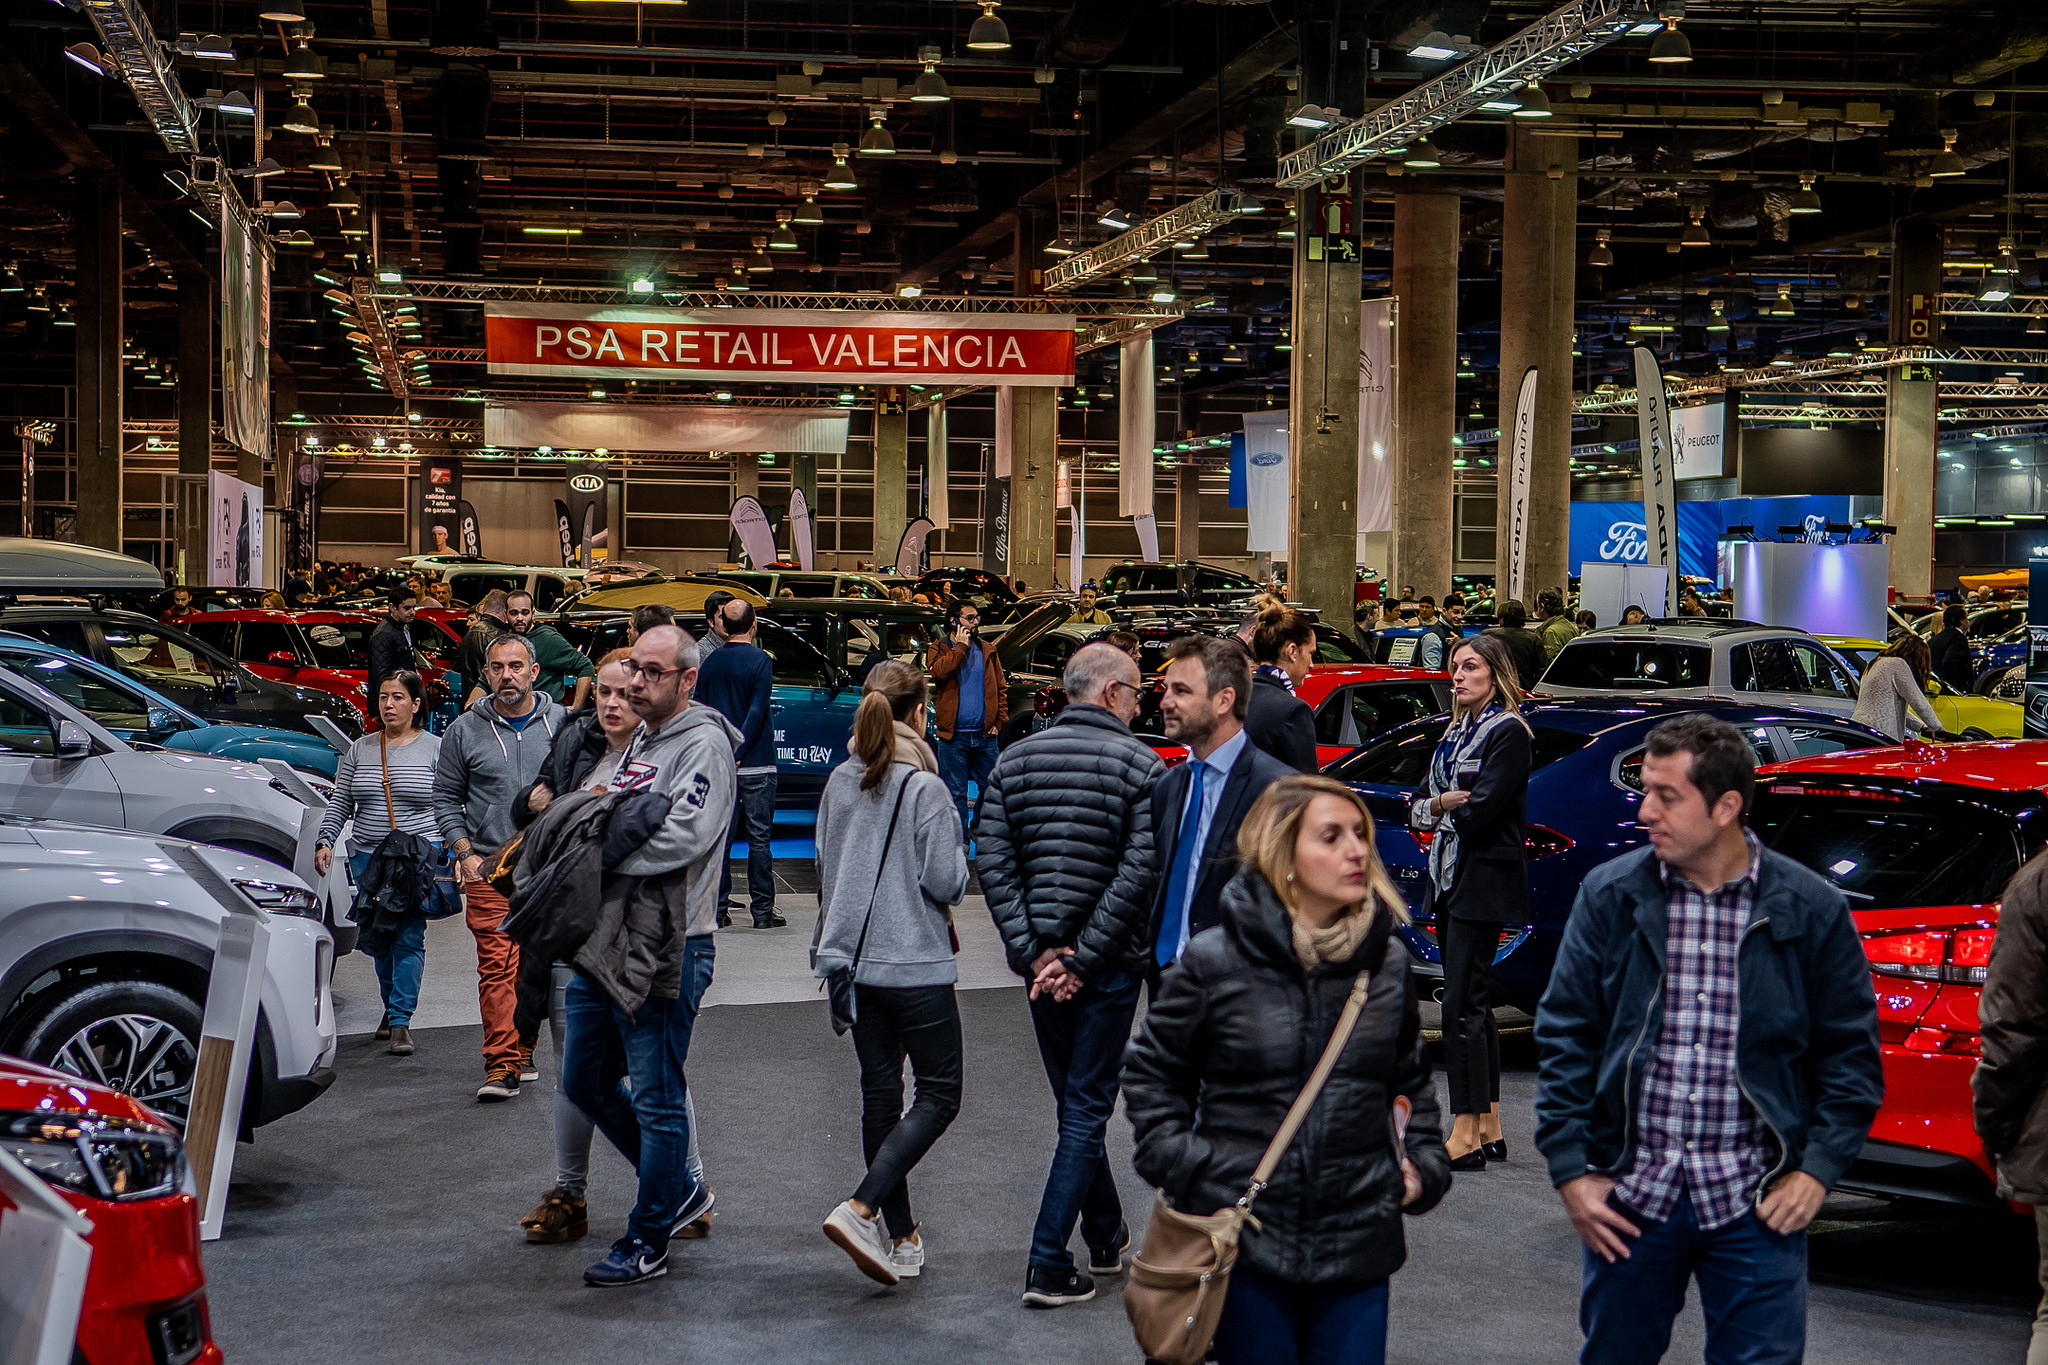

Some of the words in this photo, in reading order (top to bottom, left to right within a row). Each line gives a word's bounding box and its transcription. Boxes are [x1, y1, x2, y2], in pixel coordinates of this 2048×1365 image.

[534, 326, 625, 361] PSA
[640, 328, 793, 365] RETAIL
[808, 332, 1027, 369] VALENCIA
[1518, 412, 1528, 485] PLAUTO
[1687, 434, 1720, 447] PEUGEOT
[576, 478, 598, 488] KIA
[995, 488, 1008, 531] Romeo
[995, 531, 1009, 561] Alfa
[777, 748, 795, 759] TIME
[799, 748, 808, 759] TO
[809, 745, 832, 764] PLAY
[687, 773, 711, 809] 3
